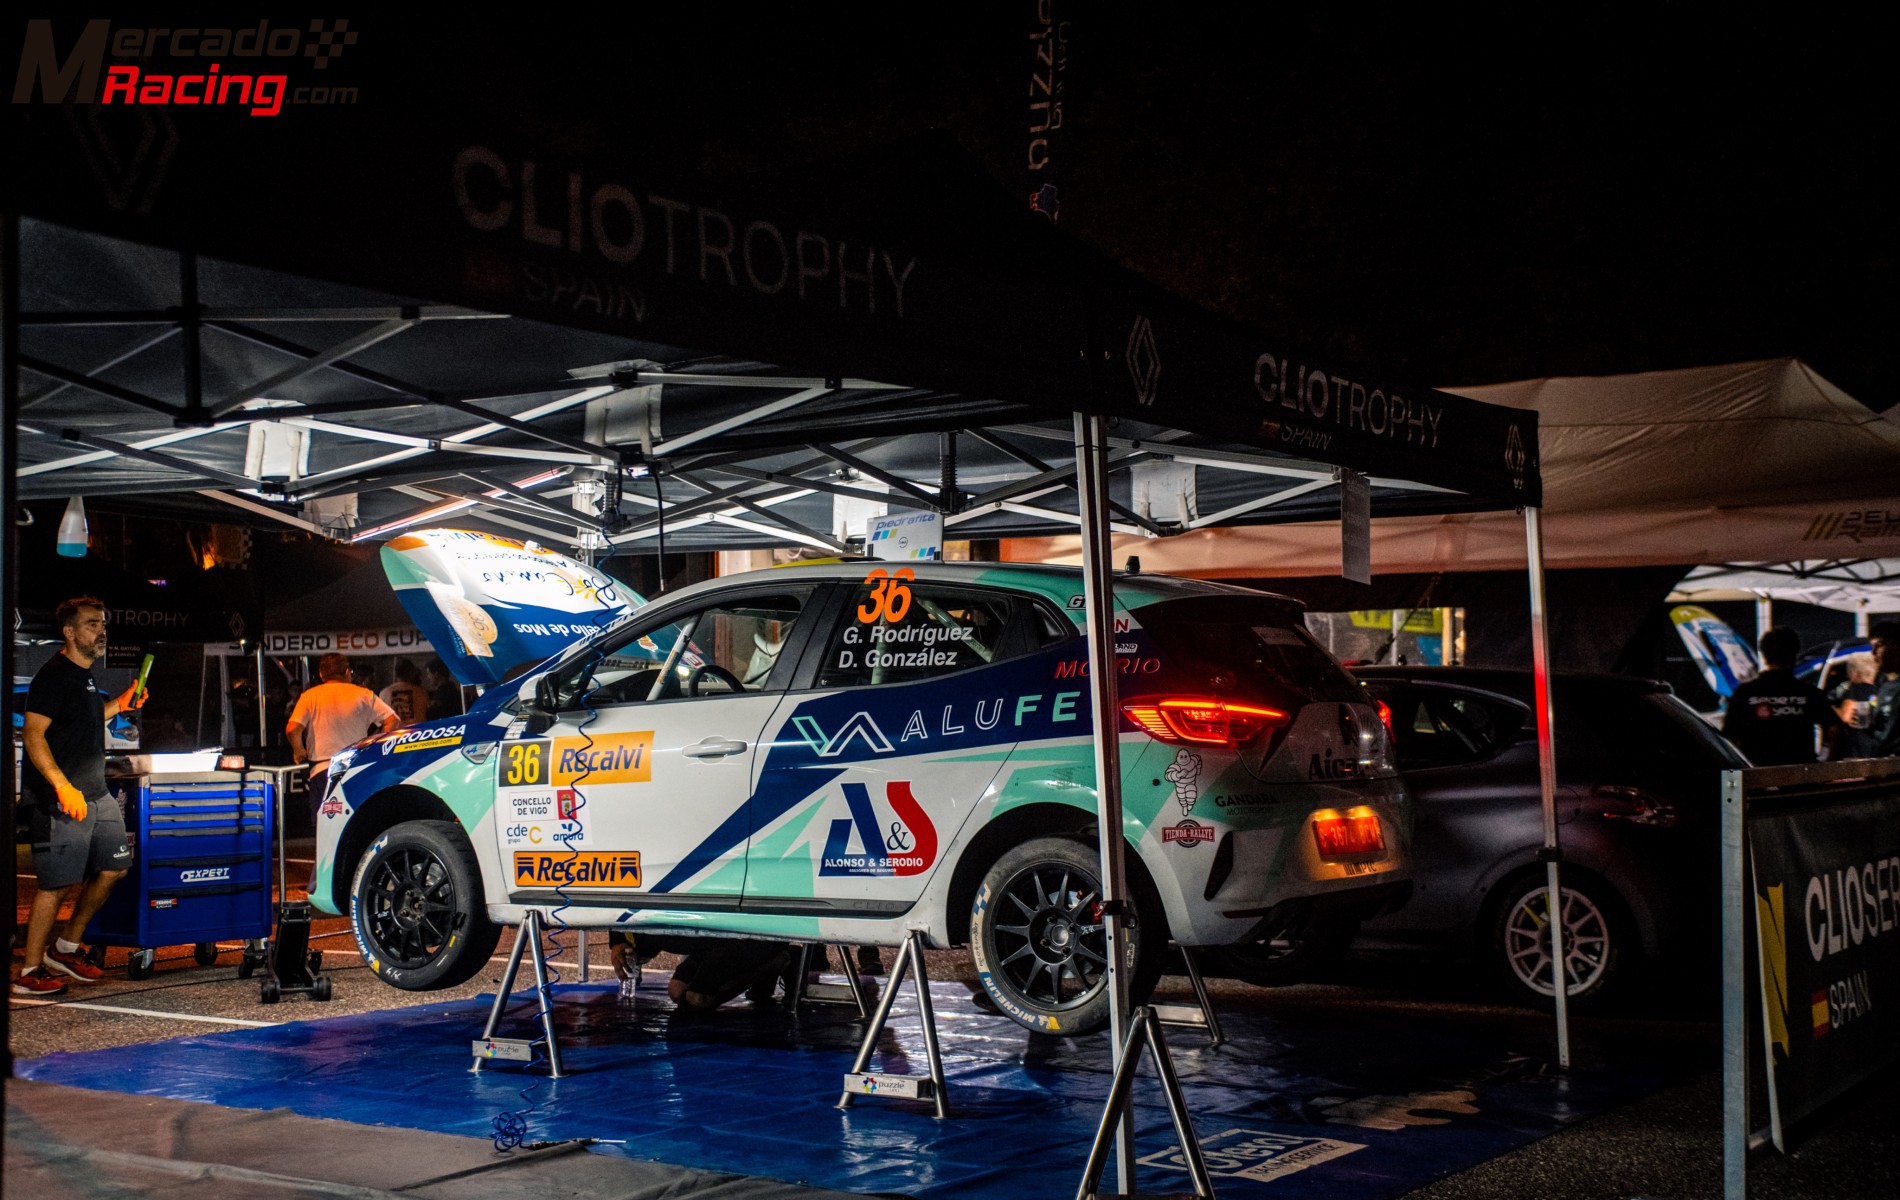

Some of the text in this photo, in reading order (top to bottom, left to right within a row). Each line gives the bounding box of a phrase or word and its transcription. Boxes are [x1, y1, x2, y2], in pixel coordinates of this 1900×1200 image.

[521, 264, 648, 323] SPAIN
[1281, 422, 1334, 451] SPAIN
[875, 513, 936, 531] piedrafita
[857, 567, 915, 624] 36
[512, 623, 551, 636] Mos
[548, 624, 570, 637] de
[843, 623, 974, 647] G. Rodríguez
[229, 634, 330, 651] NDERO
[336, 633, 379, 649] ECO
[838, 648, 958, 668] D. González
[900, 690, 1092, 742] ALUFE
[397, 724, 466, 744] RODOSA
[507, 743, 541, 785] 36
[559, 743, 644, 773] Recalvi
[512, 796, 552, 807] CONCELLO
[517, 806, 548, 815] DE VIGO
[552, 832, 584, 842] amura
[537, 856, 617, 882] Recalvi
[824, 857, 923, 868] ALONSO & SERODIO
[1804, 856, 1900, 962] CLIOSER
[352, 899, 370, 957] MICHELIN
[983, 976, 1037, 1025] MICHELIN
[1829, 969, 1872, 1030] SPAIN
[878, 1081, 905, 1090] puzzle
